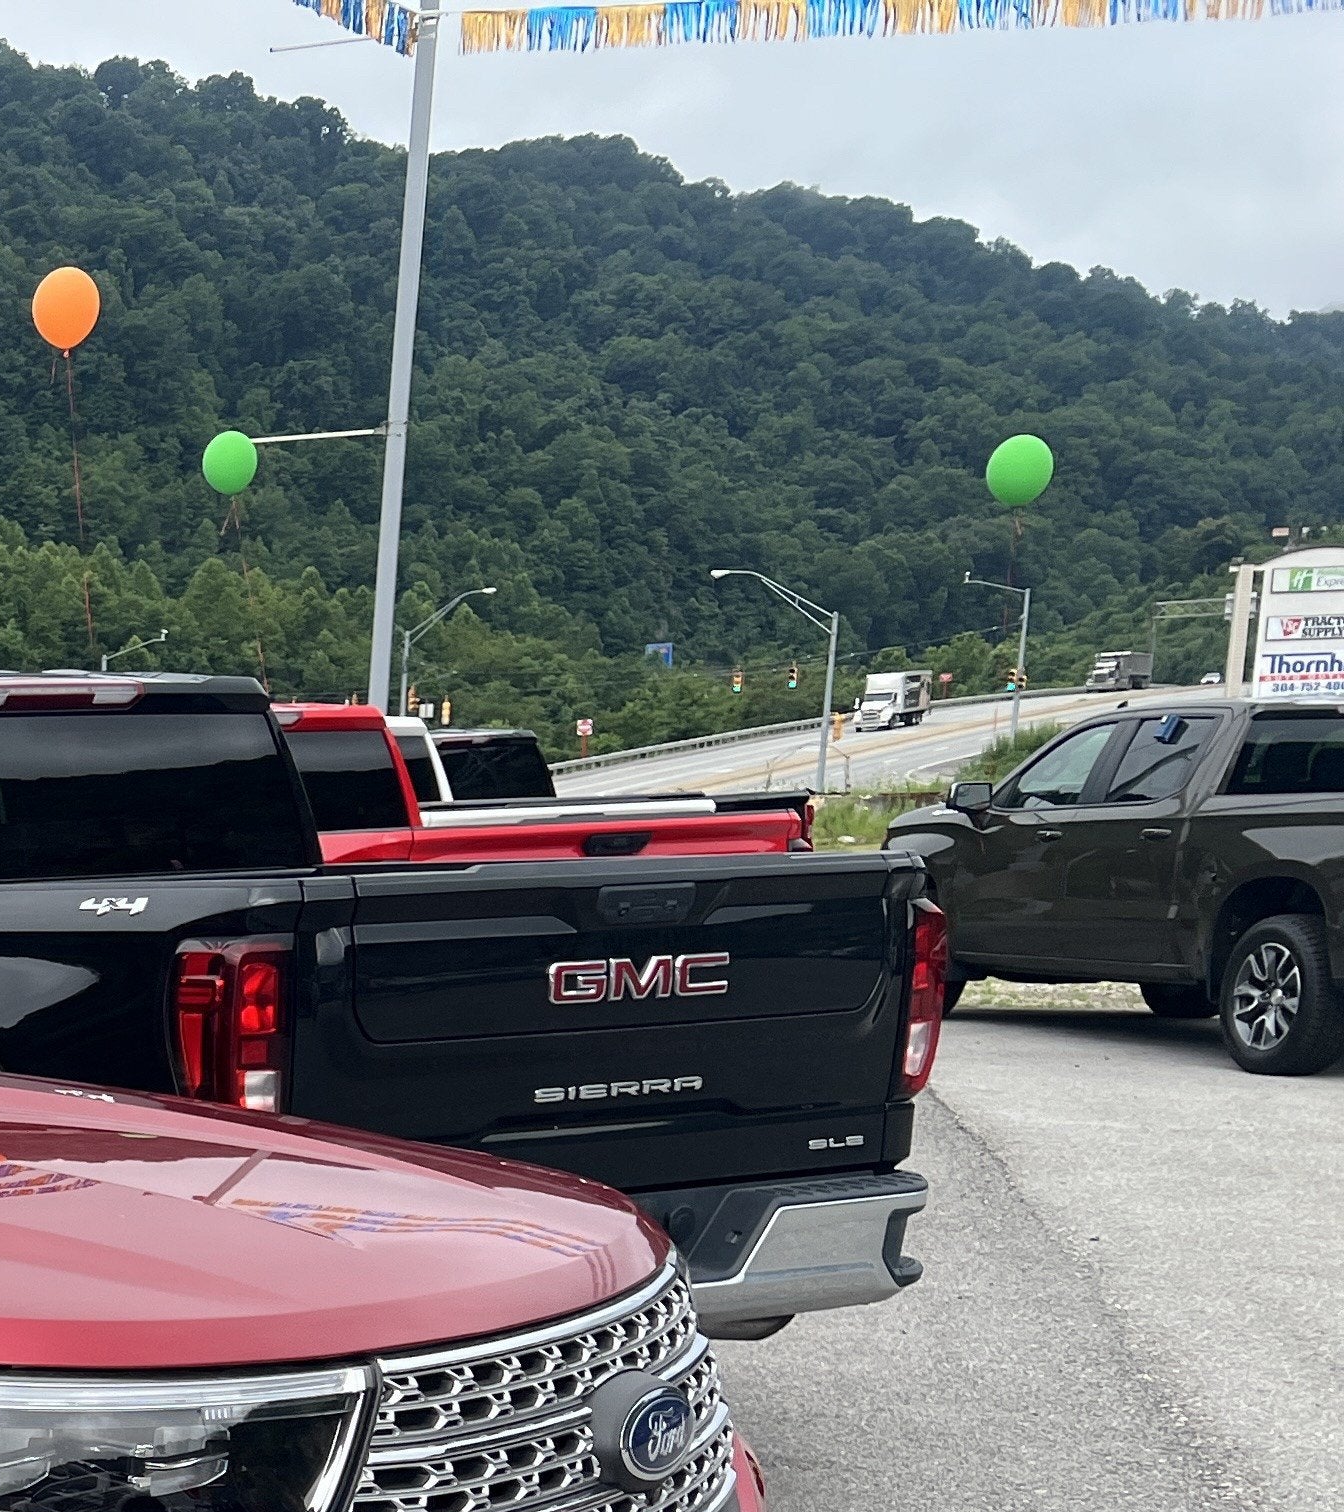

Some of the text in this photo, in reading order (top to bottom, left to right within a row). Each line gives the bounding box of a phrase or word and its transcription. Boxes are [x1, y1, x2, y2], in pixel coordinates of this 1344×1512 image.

[1302, 626, 1344, 637] SUPPLY
[1304, 616, 1344, 627] TRACT
[549, 952, 730, 1004] GMC
[534, 1075, 703, 1103] SIERRA
[647, 1406, 685, 1461] Ford
